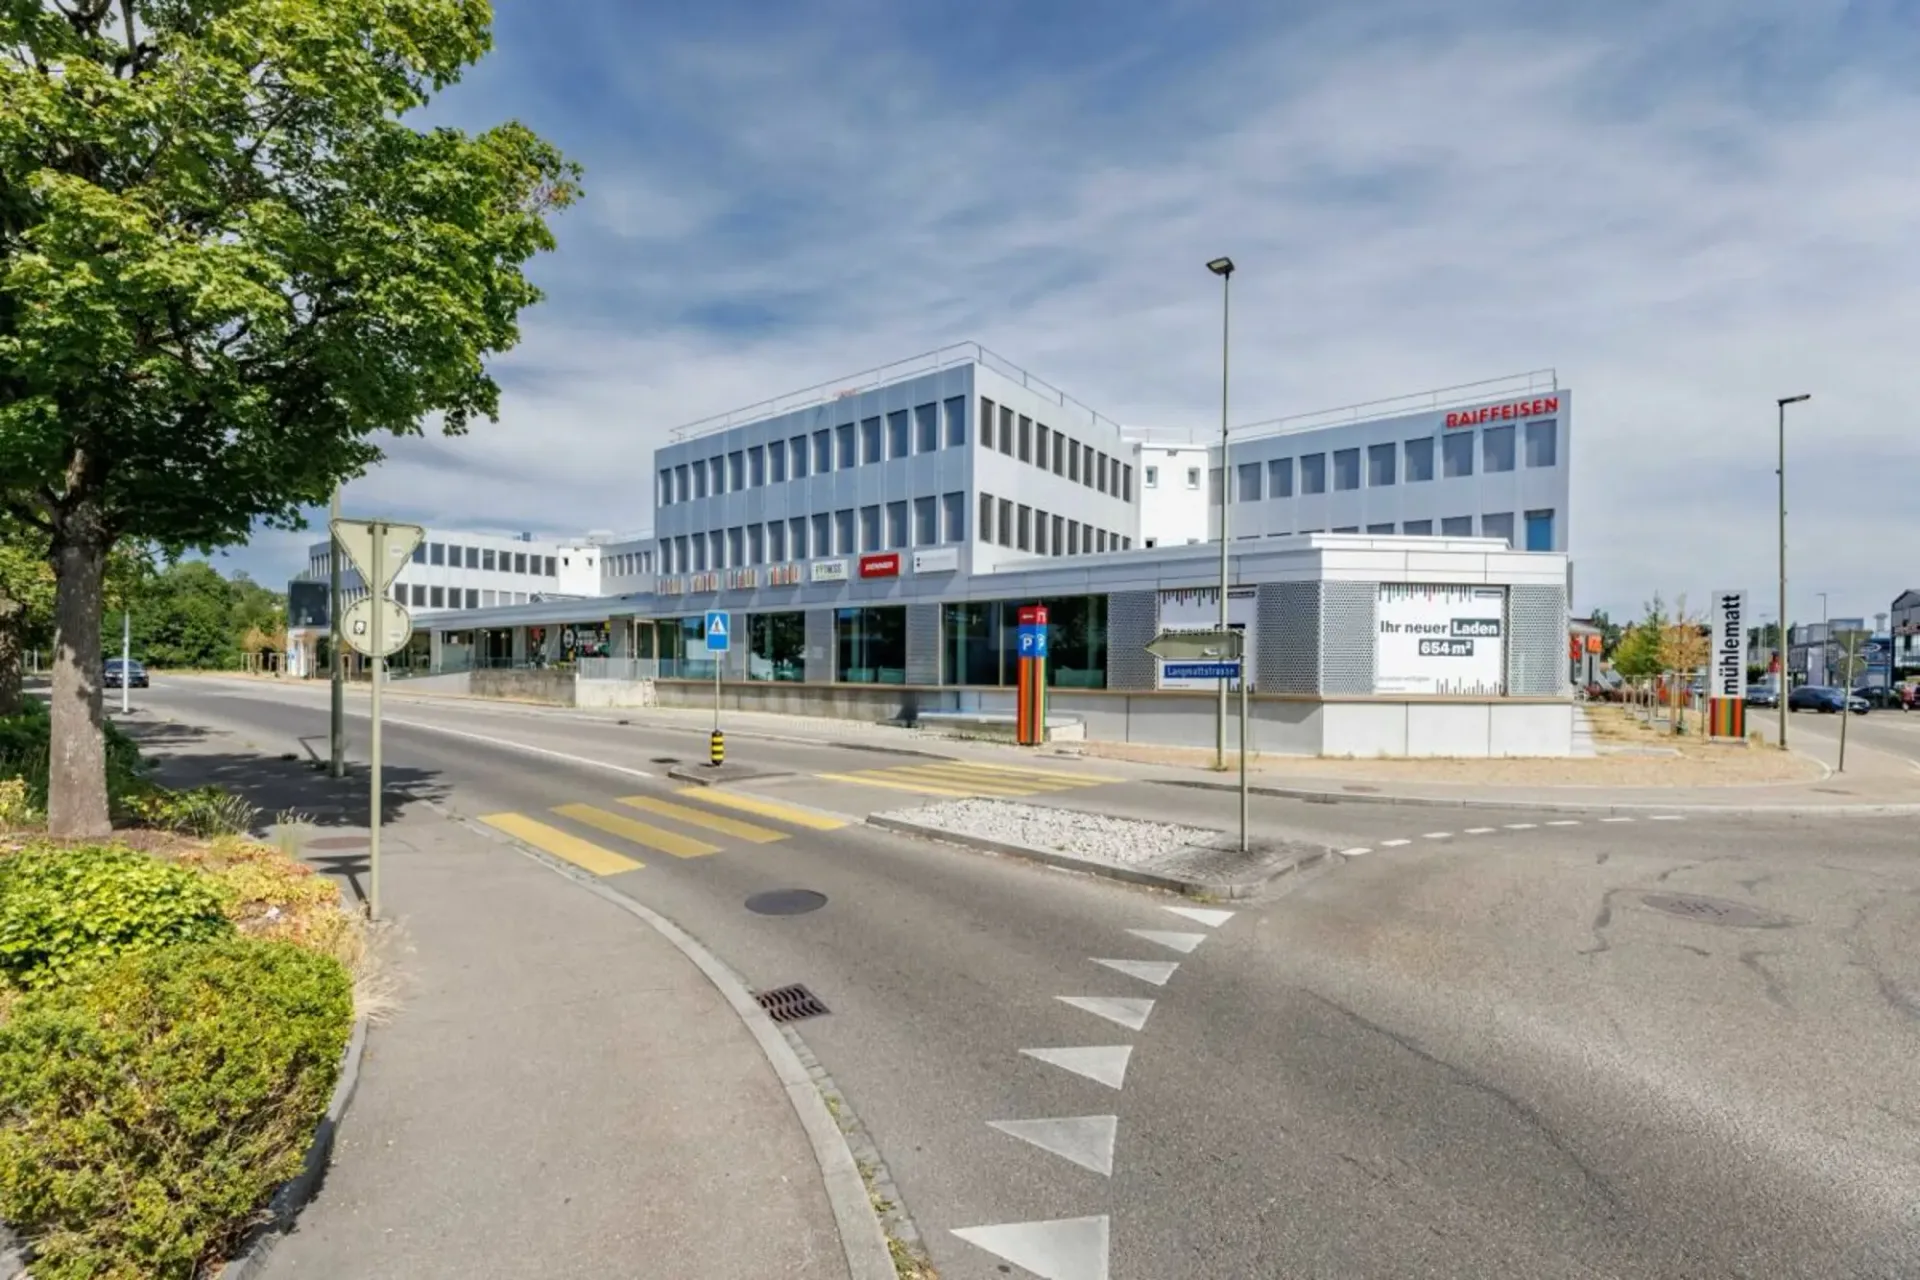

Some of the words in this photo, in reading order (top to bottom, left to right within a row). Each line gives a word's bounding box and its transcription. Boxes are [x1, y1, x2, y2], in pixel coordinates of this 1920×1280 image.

[1446, 397, 1558, 428] RAIFFEISEN
[1380, 620, 1401, 633] Ihr
[1404, 624, 1448, 634] neuer
[1453, 621, 1498, 634] Laden
[1023, 637, 1033, 650] P
[1719, 594, 1741, 695] mühlematt
